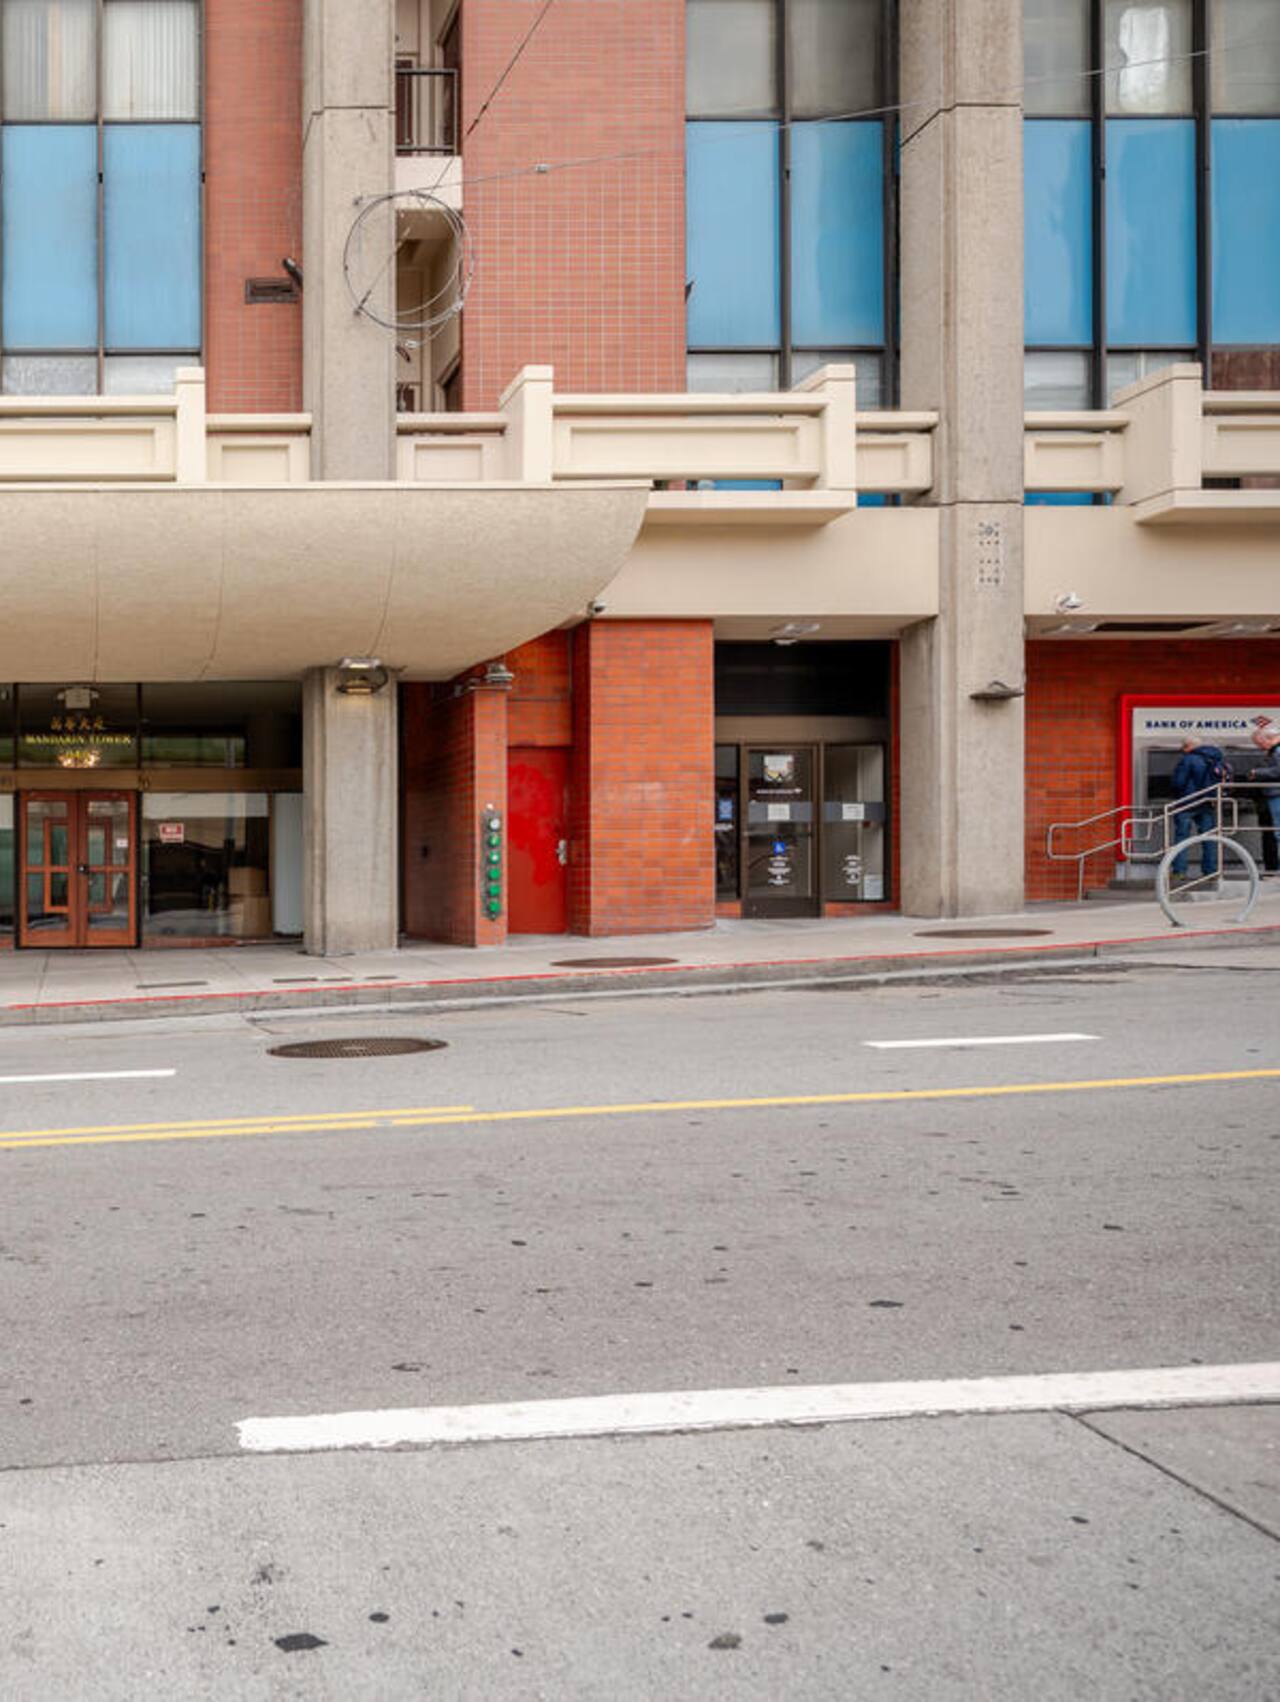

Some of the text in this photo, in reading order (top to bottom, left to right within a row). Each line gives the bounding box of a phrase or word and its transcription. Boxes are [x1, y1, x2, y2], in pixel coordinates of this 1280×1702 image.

[1145, 719, 1248, 729] BANK OF AMERICA
[24, 733, 132, 745] MANDARIN TOWER
